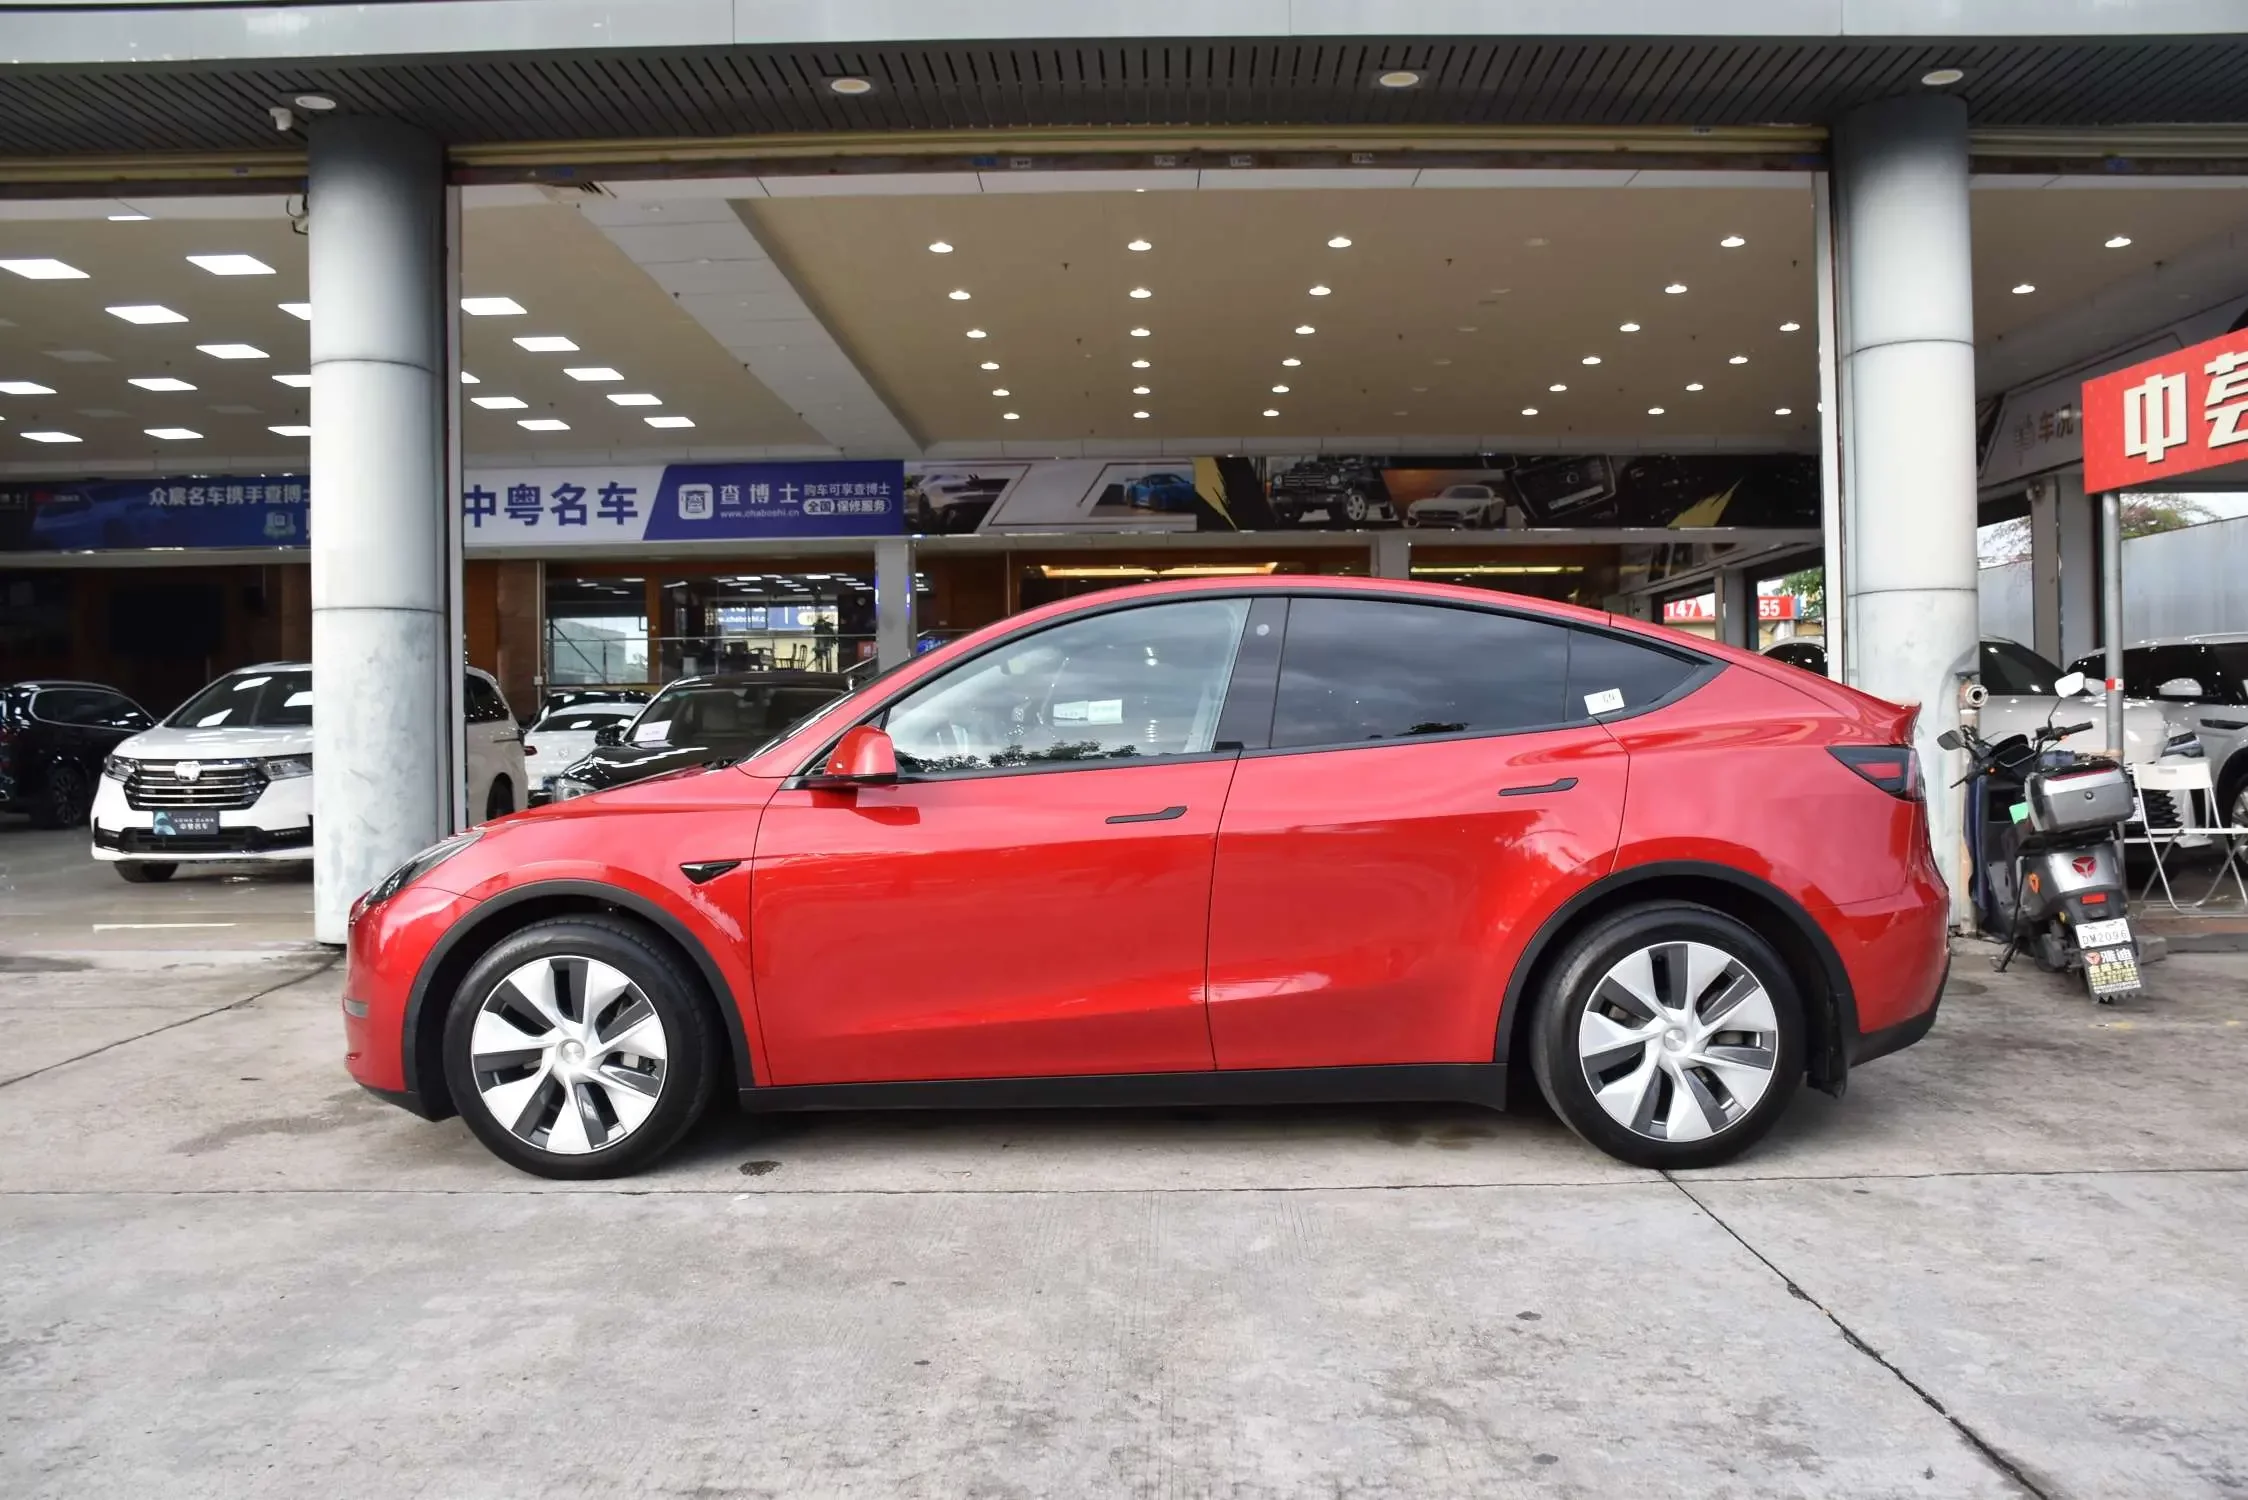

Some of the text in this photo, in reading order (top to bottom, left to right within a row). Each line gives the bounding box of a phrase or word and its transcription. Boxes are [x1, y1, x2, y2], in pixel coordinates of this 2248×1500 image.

[720, 482, 799, 505] 查博士
[464, 481, 639, 528] 中粤名车
[720, 509, 800, 519] www.chaboshi.cn
[1759, 600, 1780, 617] 55
